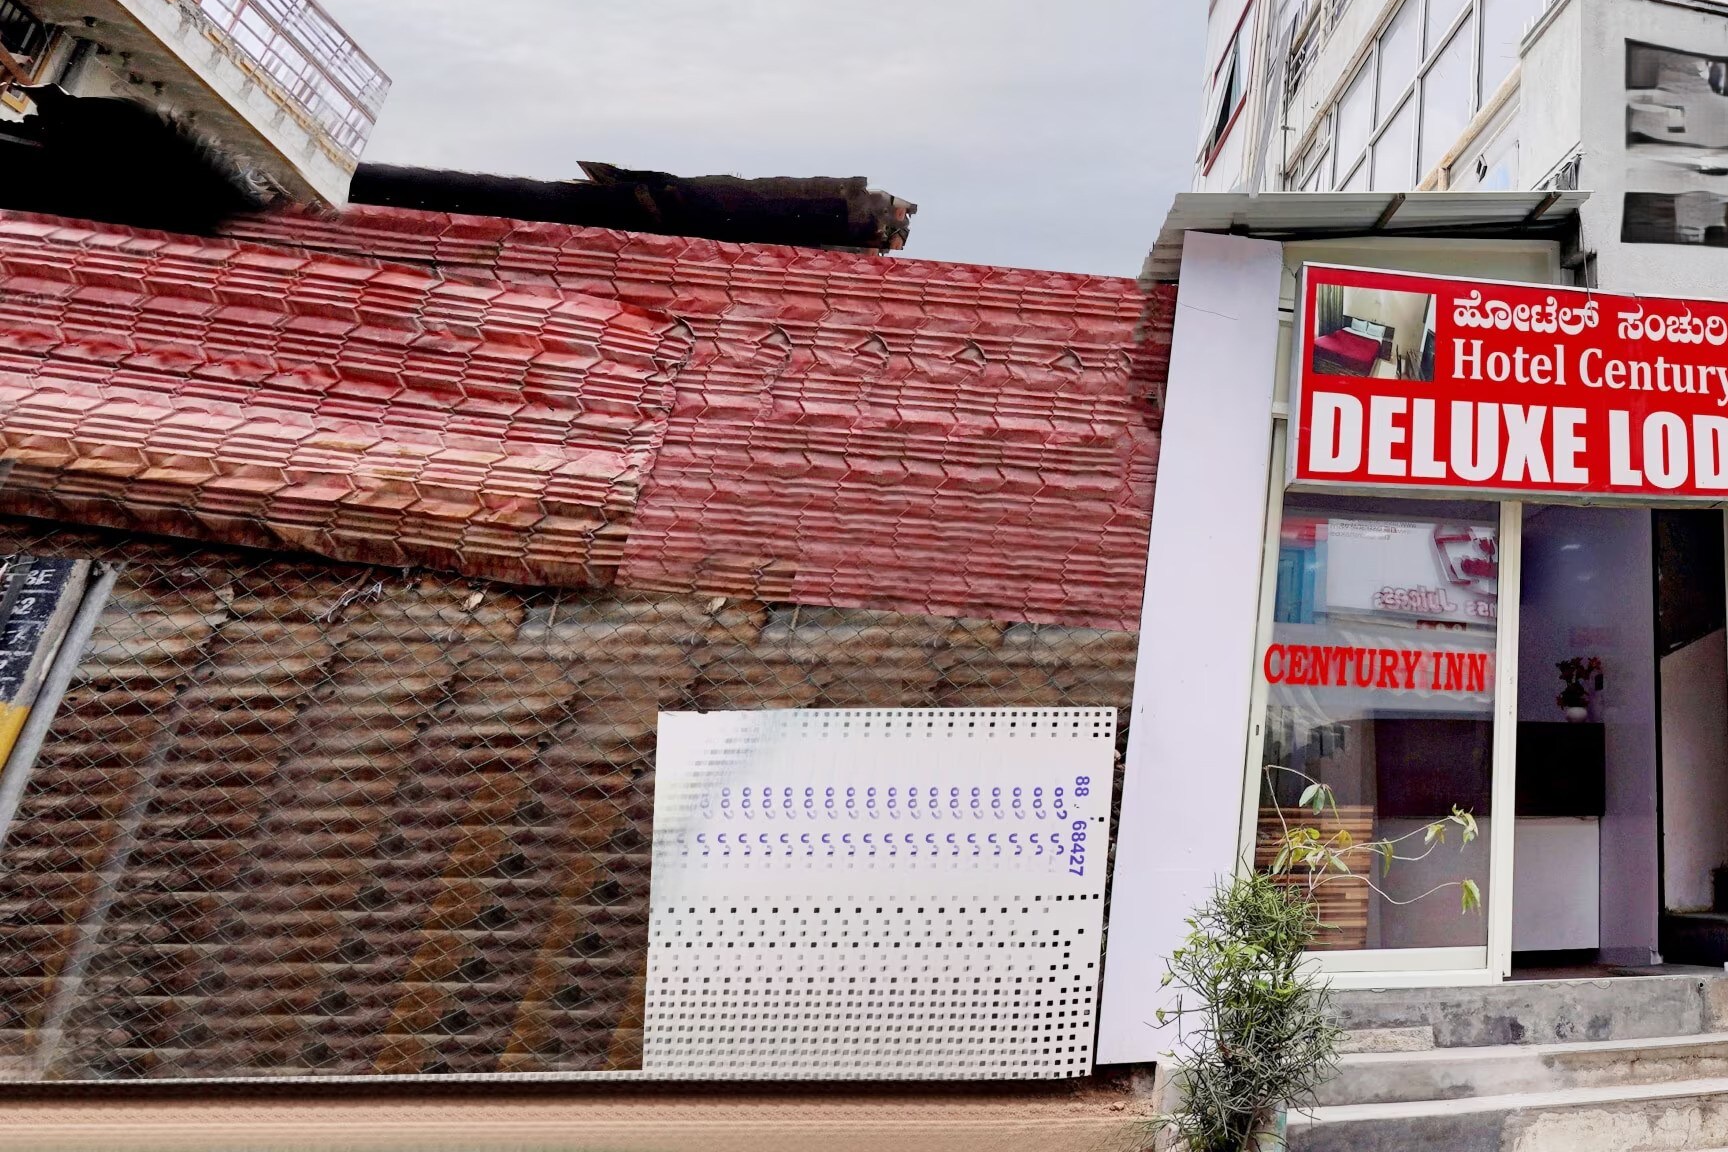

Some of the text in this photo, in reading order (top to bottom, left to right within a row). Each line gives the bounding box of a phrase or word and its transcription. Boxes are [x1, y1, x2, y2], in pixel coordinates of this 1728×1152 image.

[1453, 338, 1567, 386] Hotel
[1308, 391, 1589, 484] DELUXE
[1264, 643, 1487, 691] CENTURY INN
